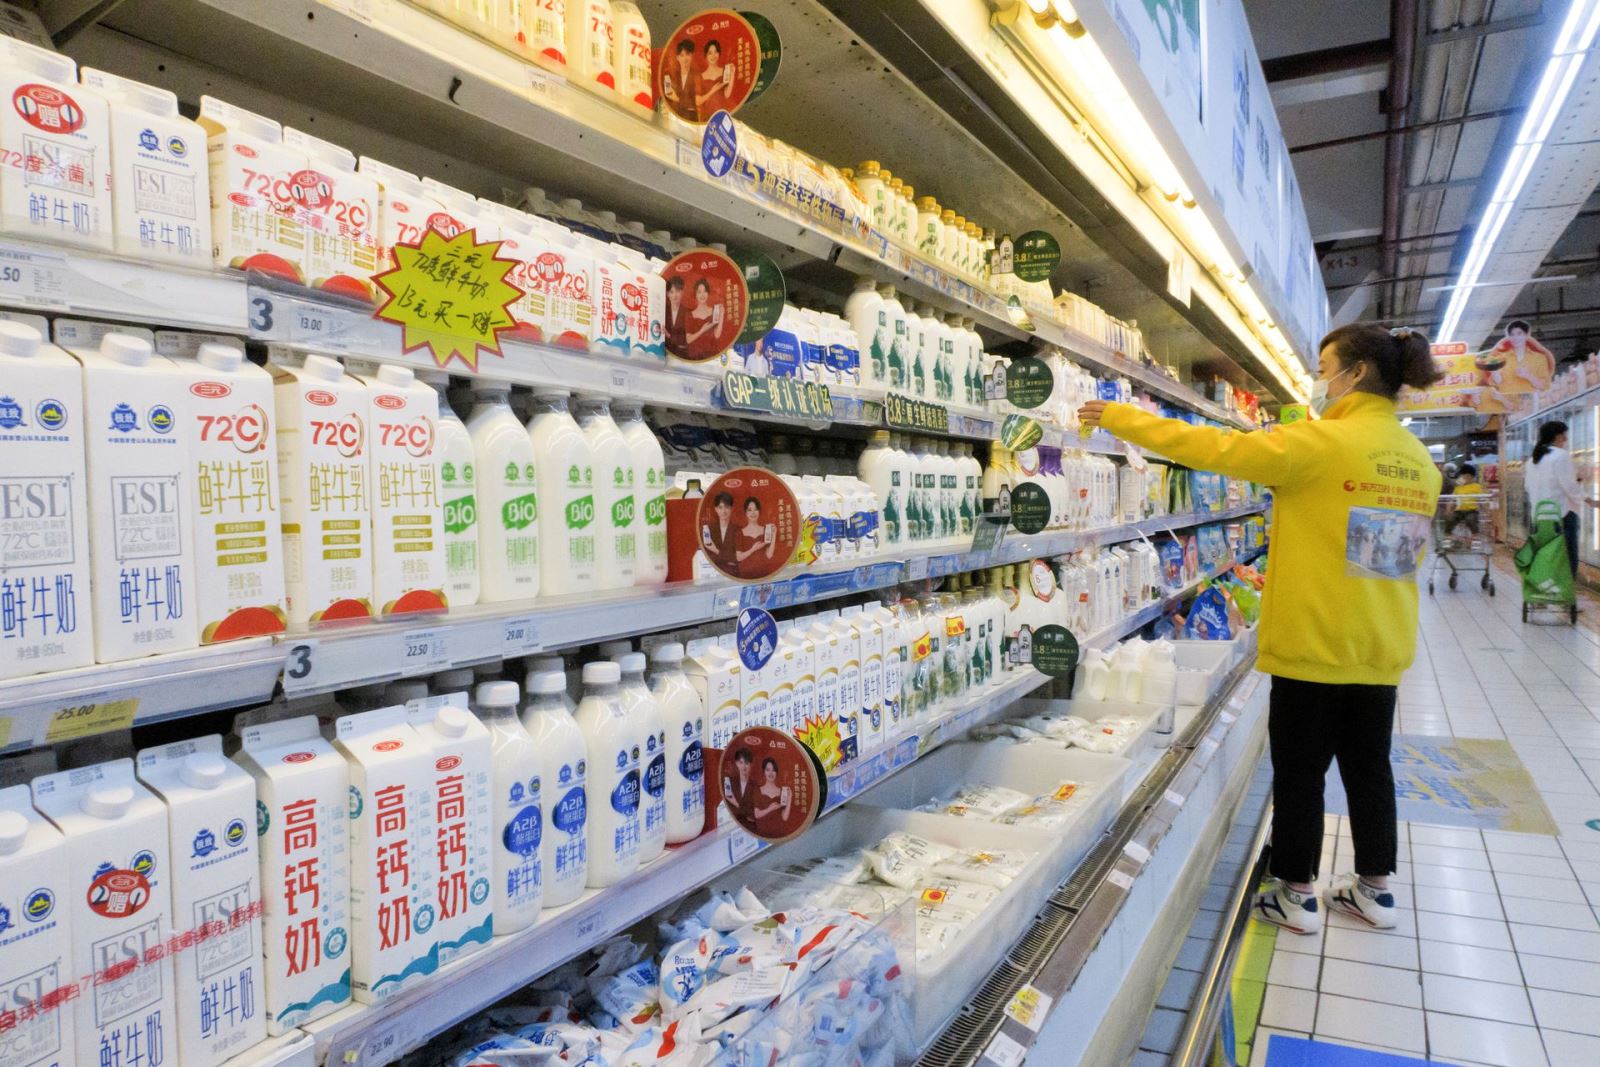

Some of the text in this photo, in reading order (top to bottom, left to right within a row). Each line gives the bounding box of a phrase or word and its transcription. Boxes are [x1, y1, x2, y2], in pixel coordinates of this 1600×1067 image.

[29, 192, 90, 237] 鲜牛奶
[139, 217, 192, 257] 鲜牛奶
[446, 245, 484, 269] 三元
[1326, 256, 1358, 270] X1-3
[251, 298, 273, 332] 3
[196, 414, 259, 442] 72°C
[310, 420, 357, 448] 72°C
[379, 423, 427, 448] 72°C
[1, 482, 67, 520] ESL
[117, 481, 175, 515] ESL
[199, 460, 276, 515] 鲜牛乳
[310, 461, 368, 512] 鲜牛乳
[380, 461, 440, 509] 鲜牛乳
[1, 573, 76, 639] 鲜牛奶
[120, 565, 183, 624] 鲜牛奶
[288, 645, 312, 679] 3
[407, 644, 428, 657] 22.50
[57, 704, 95, 721] 25.00
[375, 783, 410, 951] 高钙奶
[436, 774, 468, 922] 高钙奶
[555, 838, 586, 873] 鲜牛奶
[283, 798, 321, 978] 高钙奶
[507, 860, 542, 898] 鲜牛奶
[106, 892, 129, 914] 赠
[201, 966, 255, 1040] 鲜牛奶
[99, 1010, 164, 1067] 鲜牛奶
